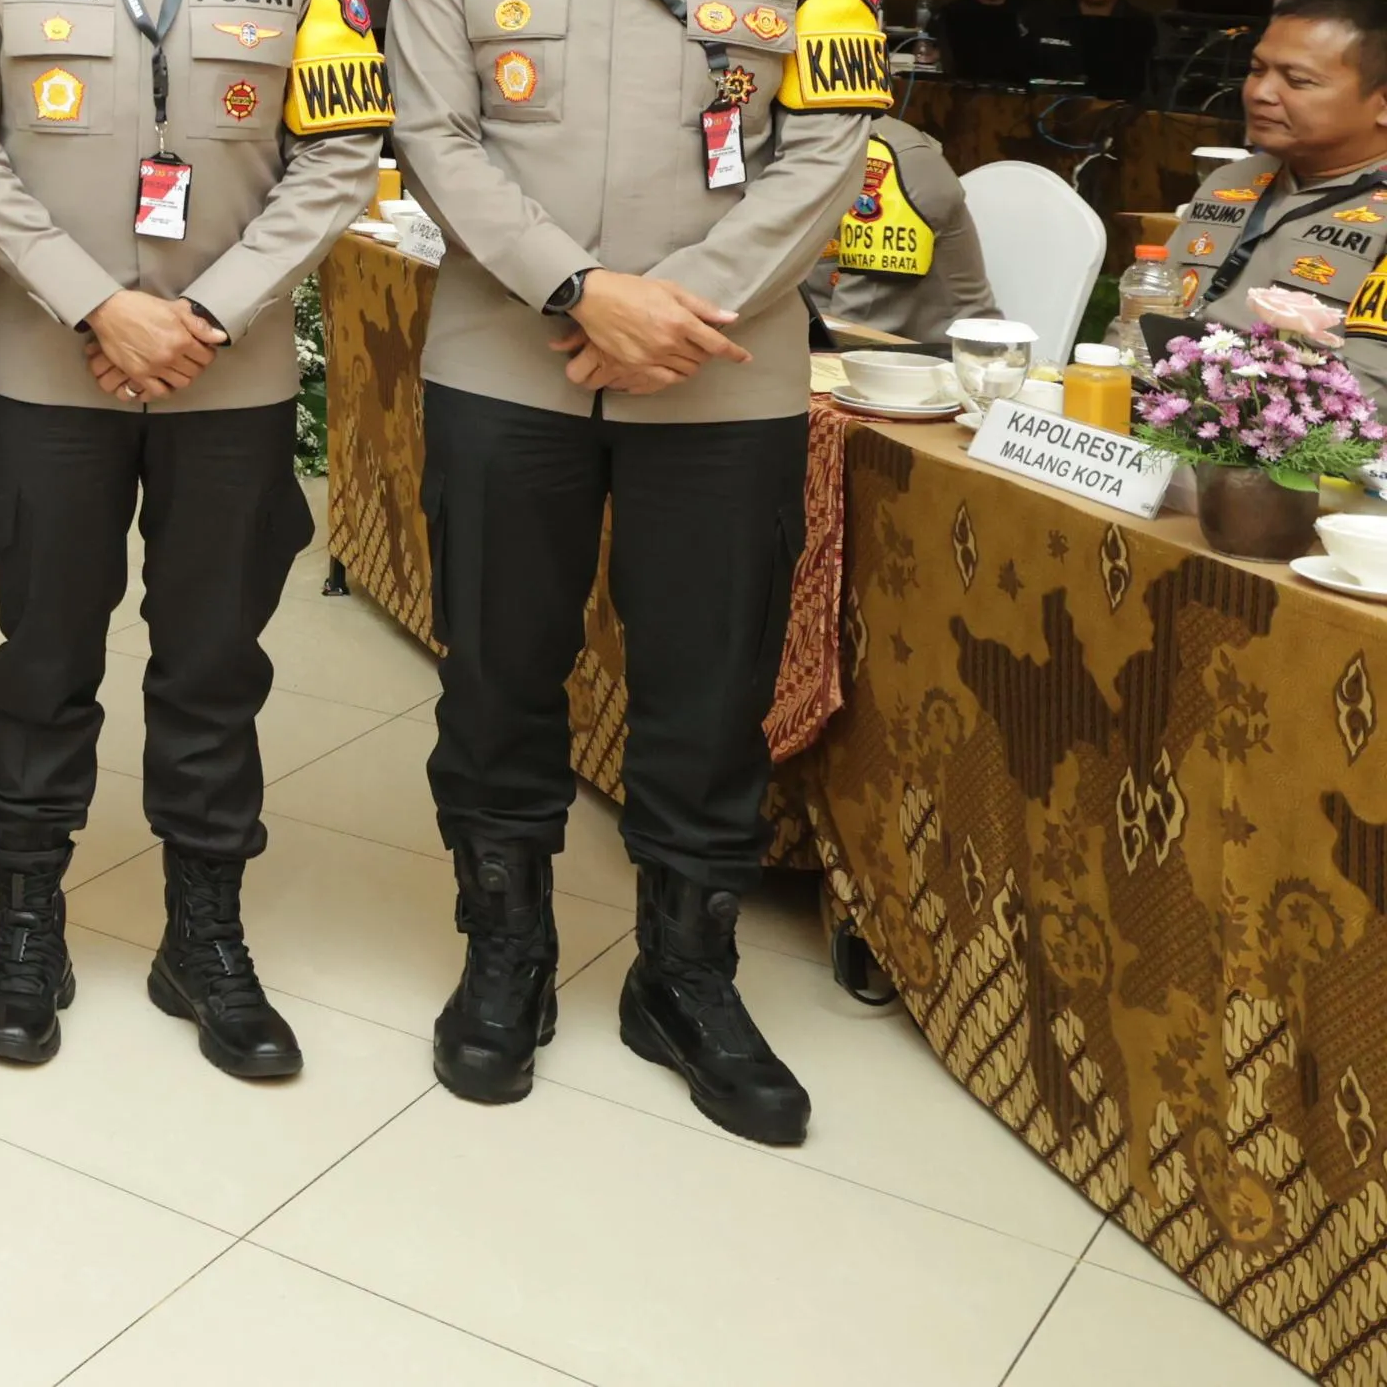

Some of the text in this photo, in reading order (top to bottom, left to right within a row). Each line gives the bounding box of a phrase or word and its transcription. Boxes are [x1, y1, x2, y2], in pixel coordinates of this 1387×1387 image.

[806, 37, 892, 93] KAWAS
[1190, 201, 1246, 224] KUSUMO
[844, 223, 918, 253] OPS RES
[1302, 224, 1373, 254] POLRI
[882, 255, 918, 271] BRATA
[1007, 410, 1144, 473] KAPOLRESTA
[1000, 440, 1124, 497] MALANG KOTA
